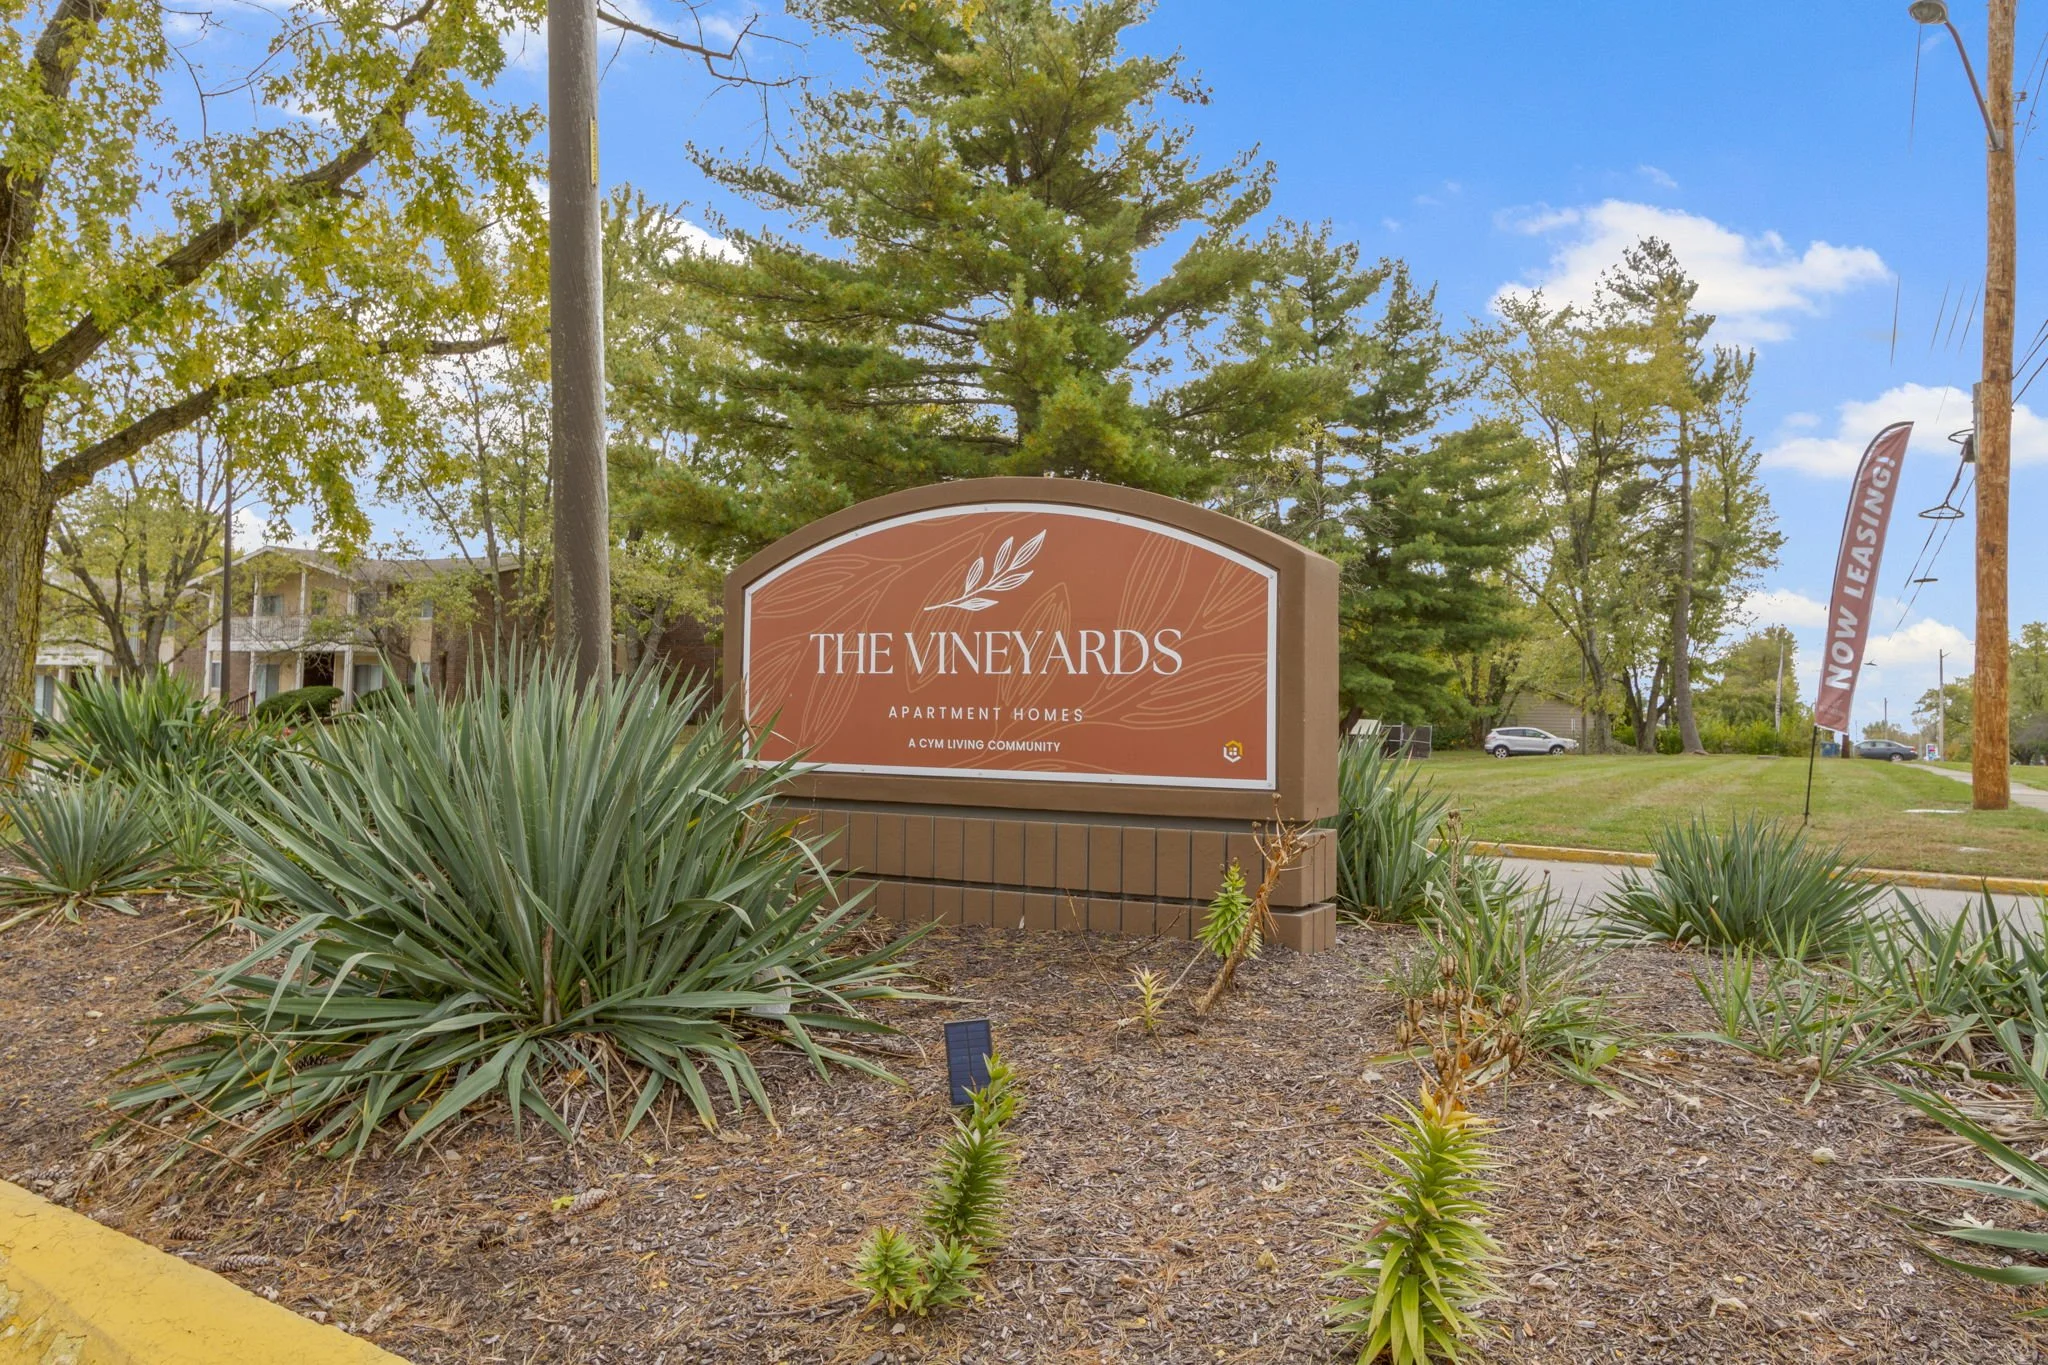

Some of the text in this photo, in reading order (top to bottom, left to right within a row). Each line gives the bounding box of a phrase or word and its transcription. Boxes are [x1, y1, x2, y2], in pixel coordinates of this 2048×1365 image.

[1825, 606, 1858, 690] NOW
[1843, 456, 1896, 599] LEASING!
[809, 628, 1183, 675] THE VINEYARDS
[888, 706, 1084, 722] APARTMENT HOMES
[908, 738, 1061, 752] A CYM LIVING COMMUNITY
